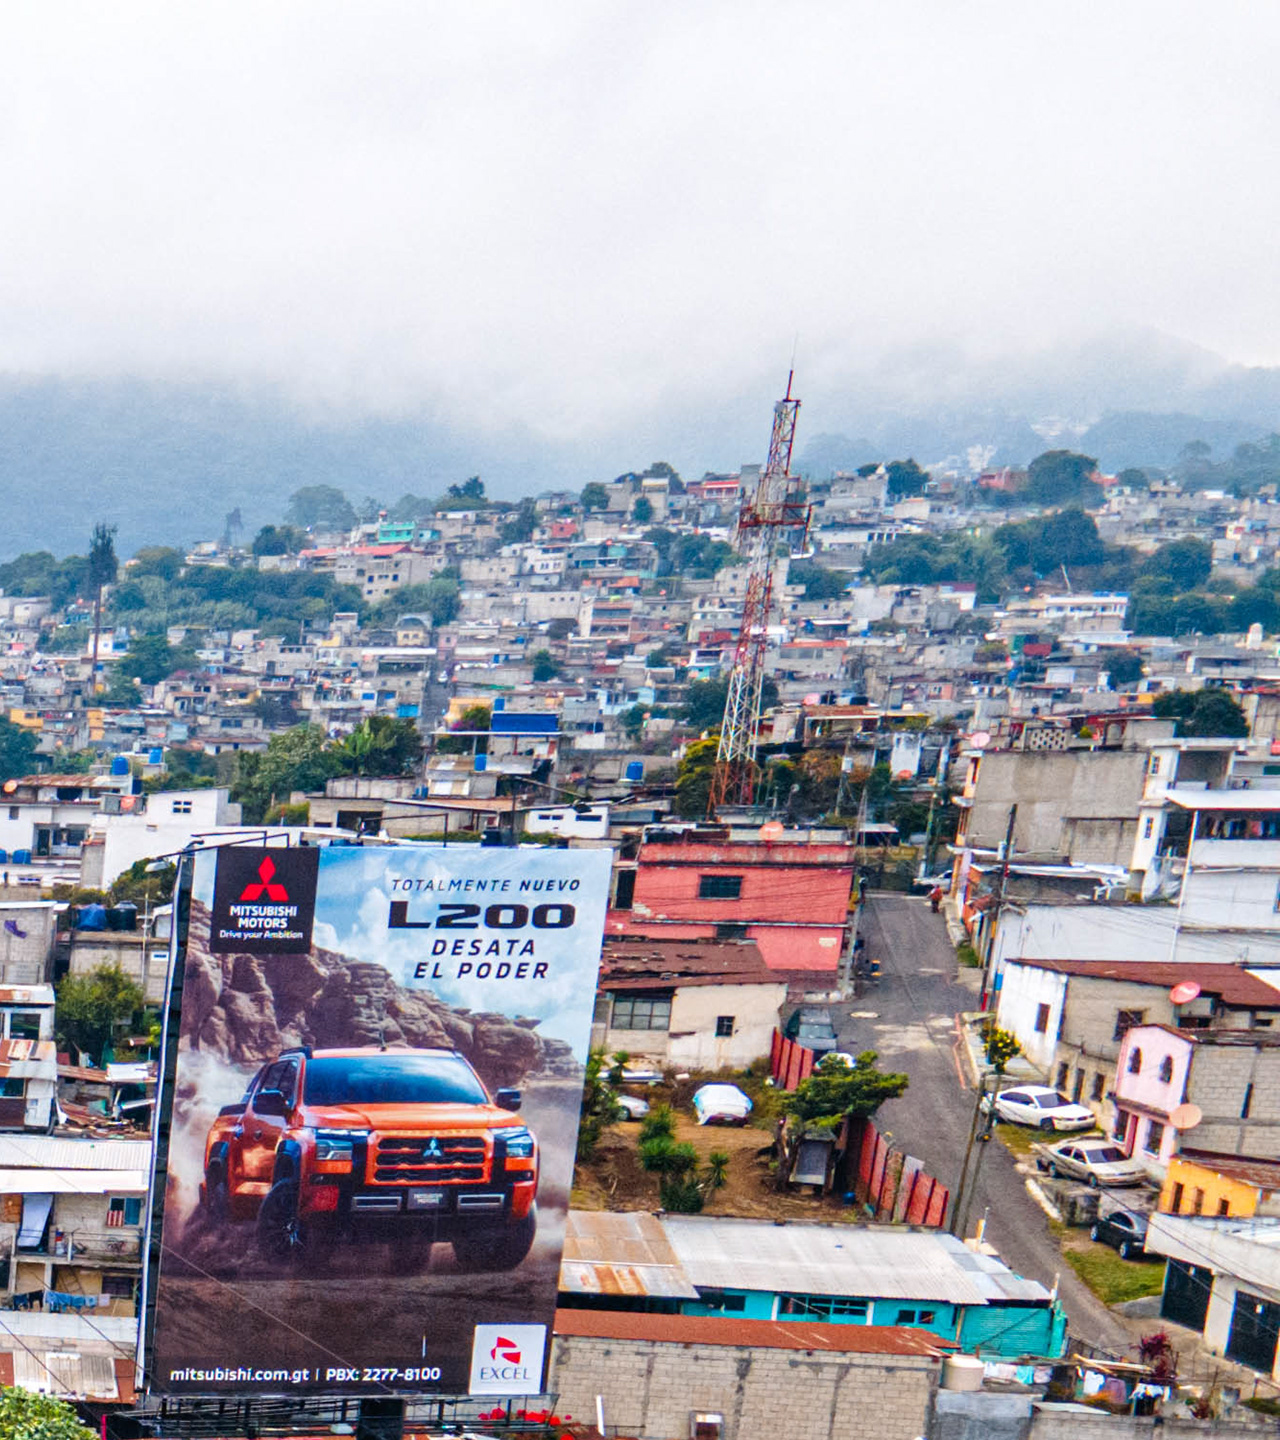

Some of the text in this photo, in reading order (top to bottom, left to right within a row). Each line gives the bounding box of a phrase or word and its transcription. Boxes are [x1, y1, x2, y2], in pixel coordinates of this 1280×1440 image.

[391, 879, 581, 892] TOTALMENTE NUEVO
[230, 905, 298, 916] MITSUBISHI
[387, 901, 576, 930] L200
[238, 917, 288, 928] MOTORS
[431, 939, 536, 956] DESATA
[413, 962, 550, 980] EL PODER
[170, 1367, 441, 1383] mitsubishi.com.gt PBX: 2277-8100
[480, 1366, 531, 1381] EXCEL
